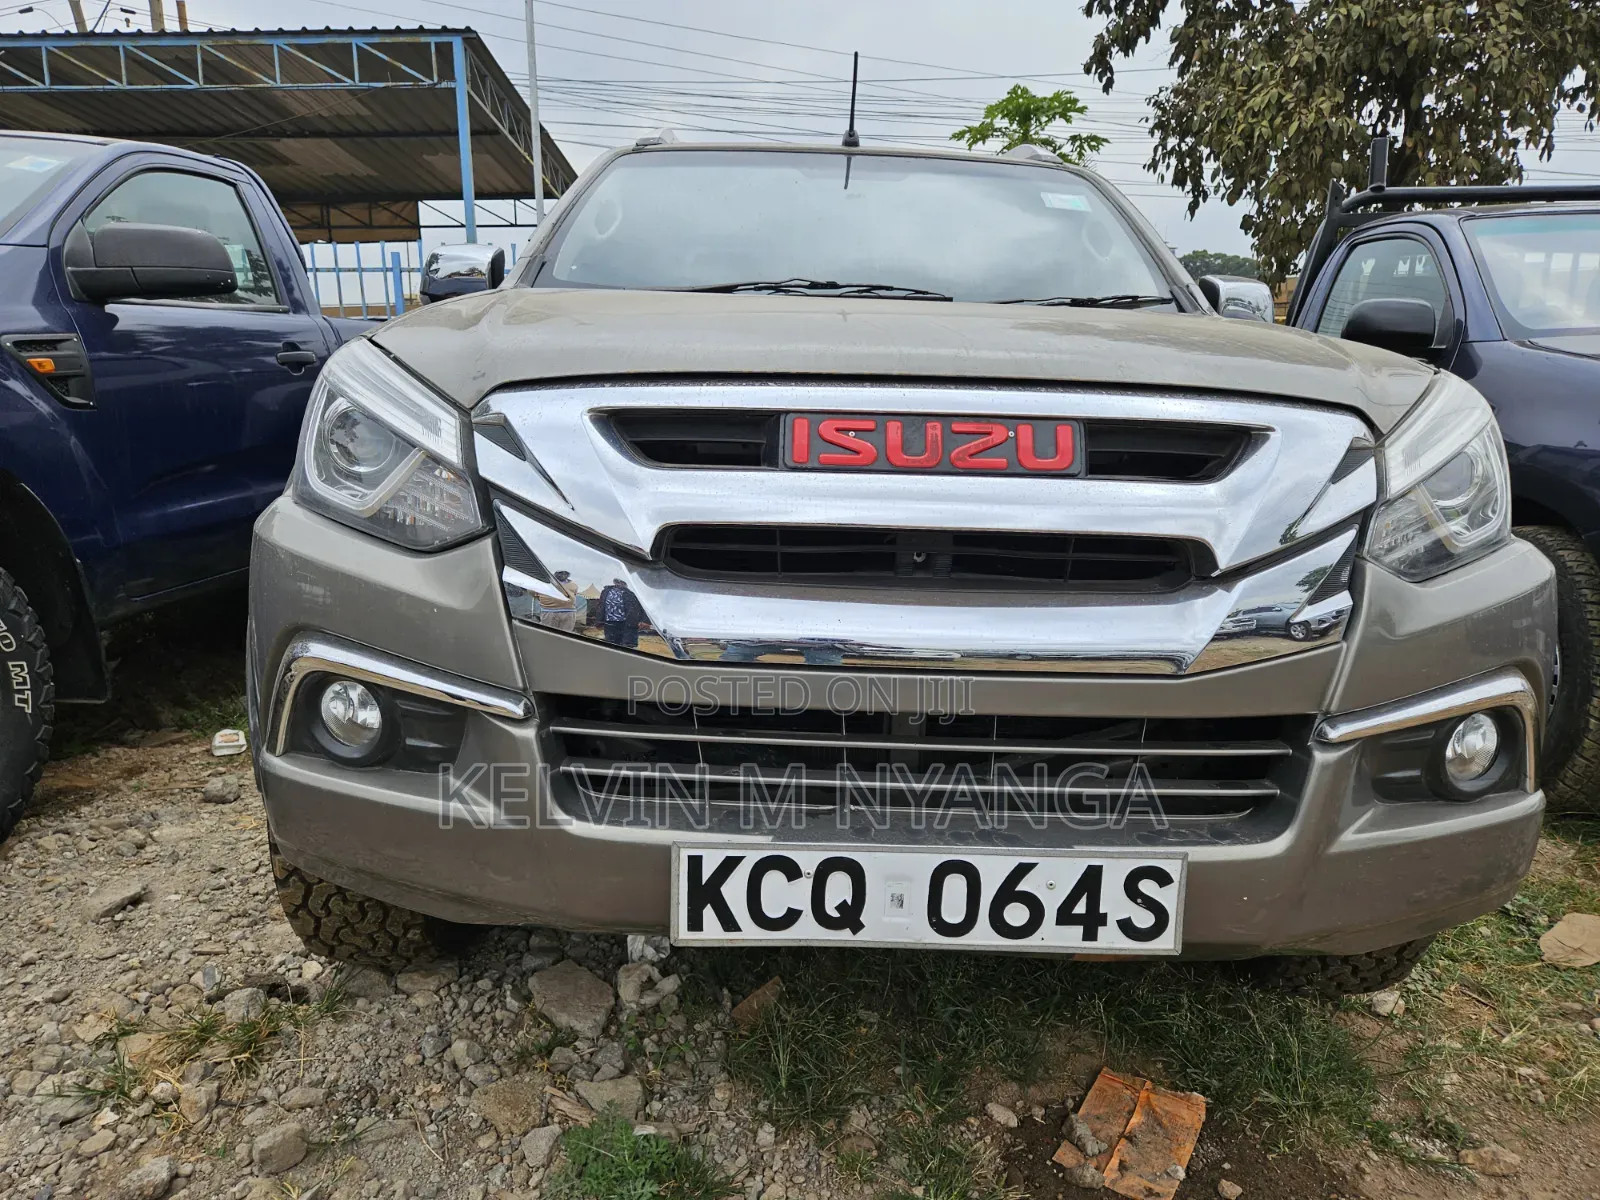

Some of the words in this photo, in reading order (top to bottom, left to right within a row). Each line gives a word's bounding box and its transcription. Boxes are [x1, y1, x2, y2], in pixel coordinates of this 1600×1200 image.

[792, 417, 1073, 470] ISUZU
[8, 661, 31, 713] MT
[687, 854, 867, 936] KCQ
[927, 859, 1174, 943] 064S
